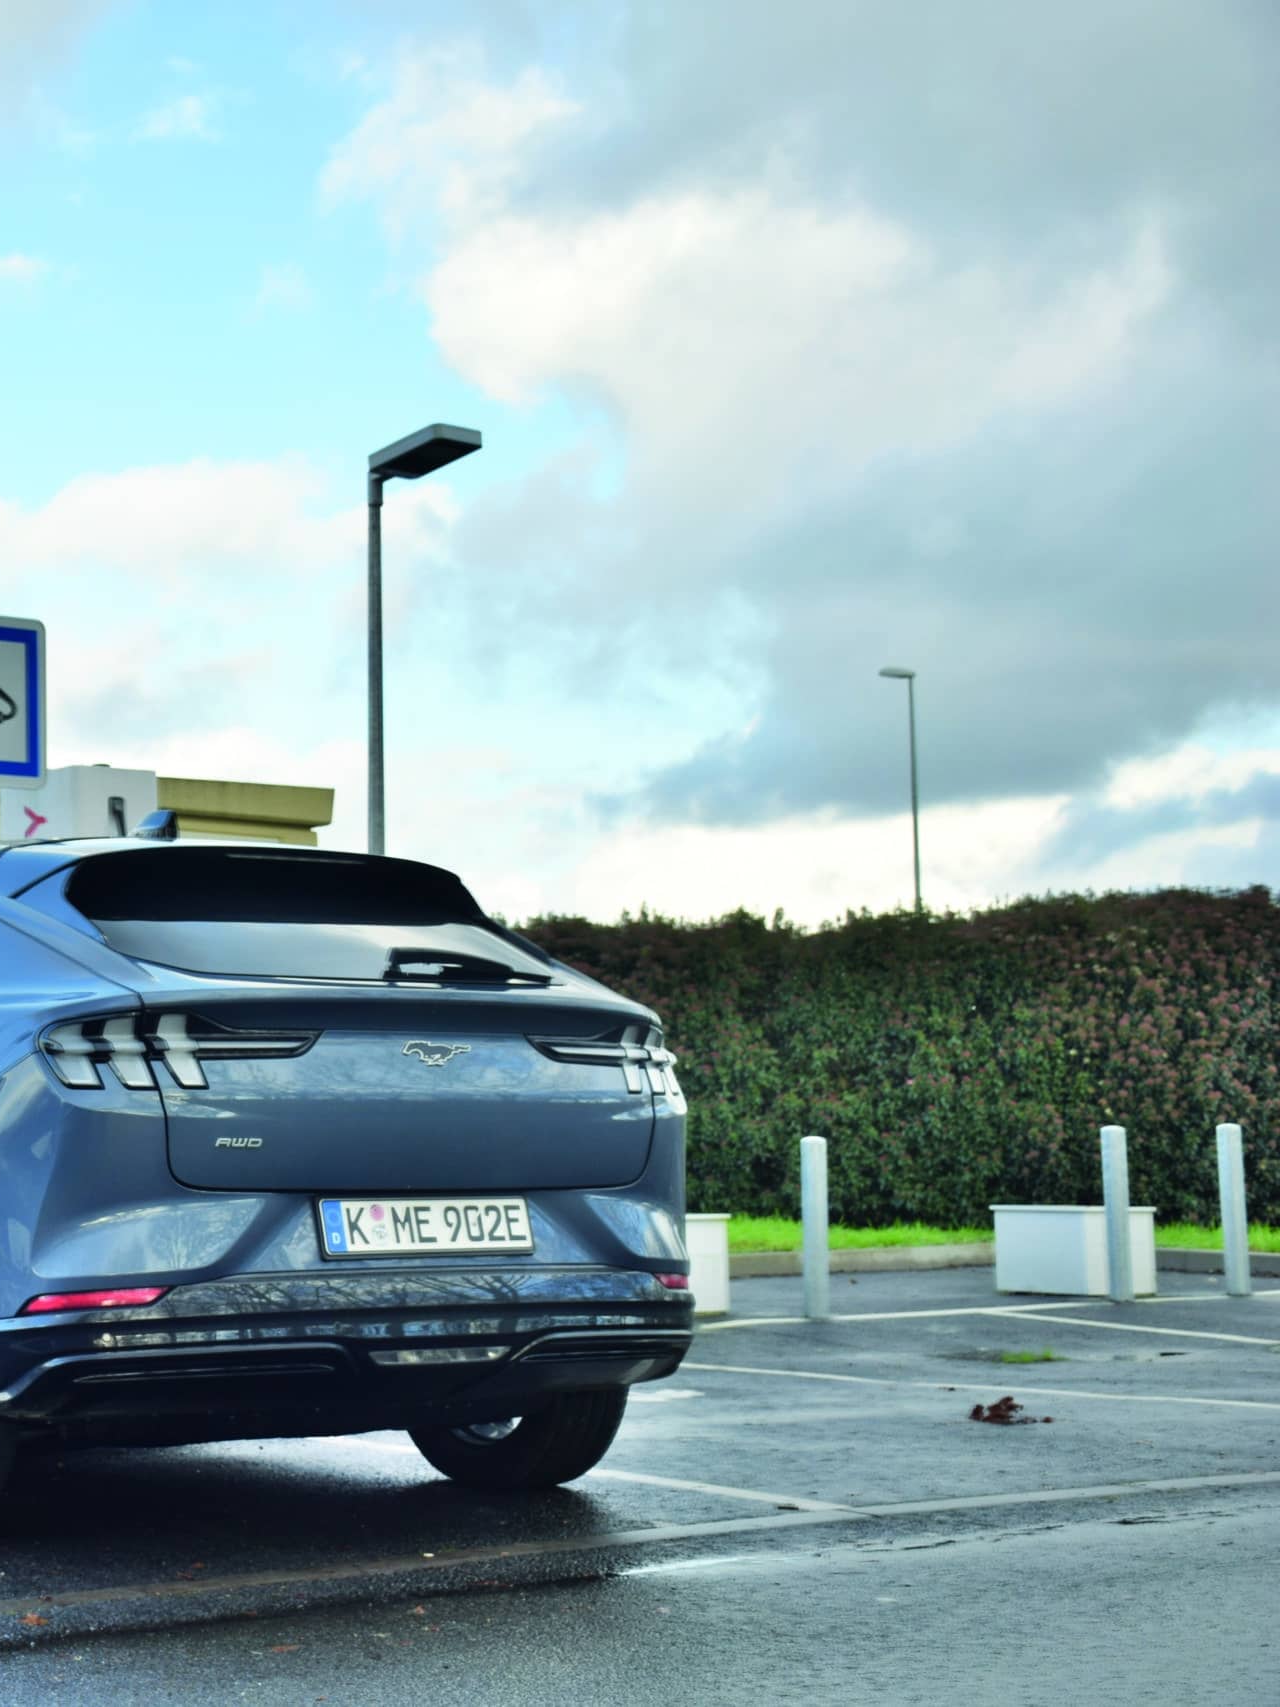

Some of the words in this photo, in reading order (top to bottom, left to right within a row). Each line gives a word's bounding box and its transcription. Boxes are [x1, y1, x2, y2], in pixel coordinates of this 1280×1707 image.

[215, 1137, 263, 1147] AWD
[346, 1207, 370, 1244] K
[391, 1206, 437, 1243] ME
[443, 1205, 527, 1242] 902E
[332, 1232, 341, 1244] D
